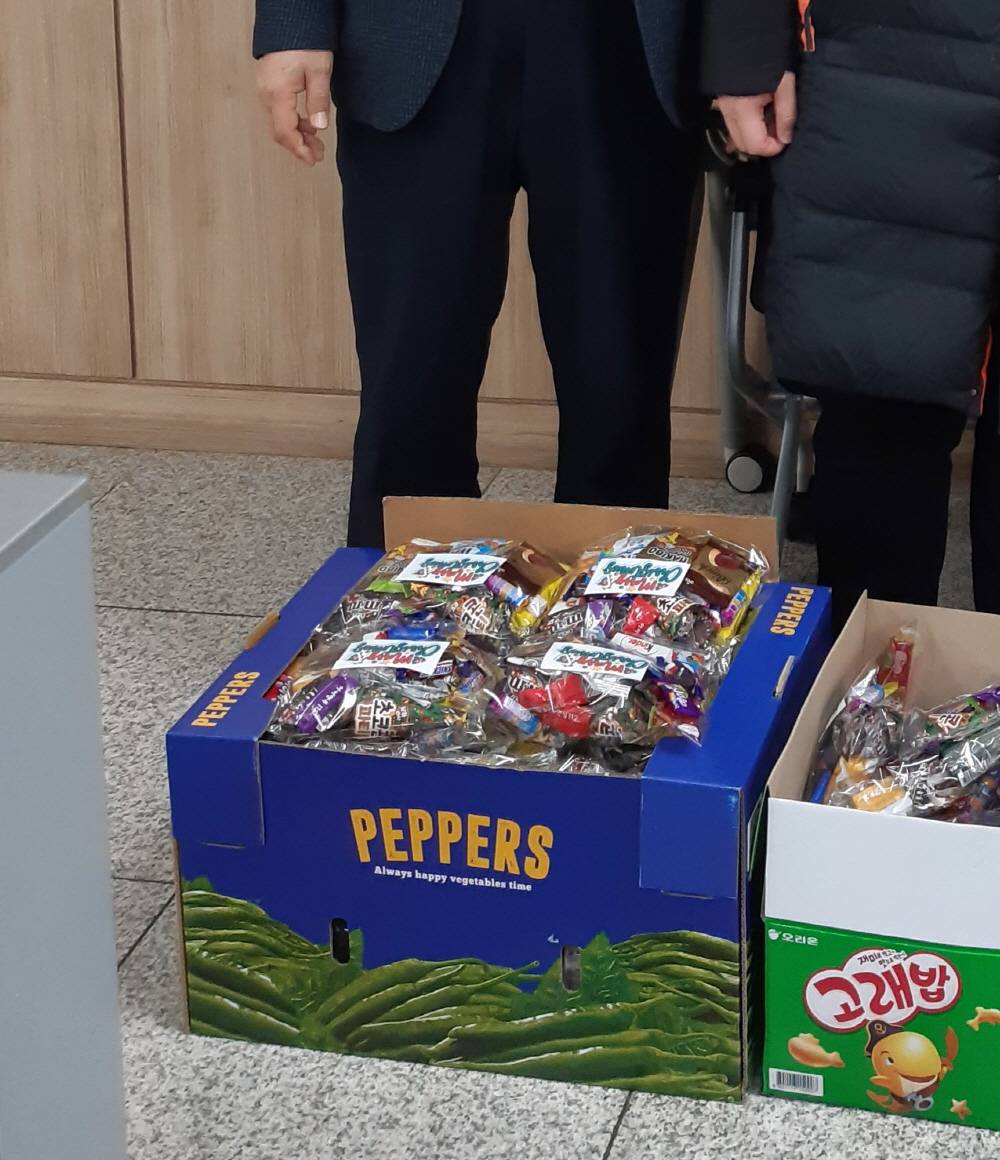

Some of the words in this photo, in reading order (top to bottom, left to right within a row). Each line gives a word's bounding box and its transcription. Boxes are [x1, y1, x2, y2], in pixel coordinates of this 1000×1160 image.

[769, 586, 815, 636] PEPPERS
[190, 671, 261, 727] PEPPERS
[350, 808, 554, 880] PEPPERS
[374, 865, 412, 879] Always
[415, 870, 447, 884] happy
[450, 875, 506, 889] vegetables
[509, 881, 532, 892] time
[782, 932, 819, 946] 오리온
[813, 961, 951, 1023] 고래밥
